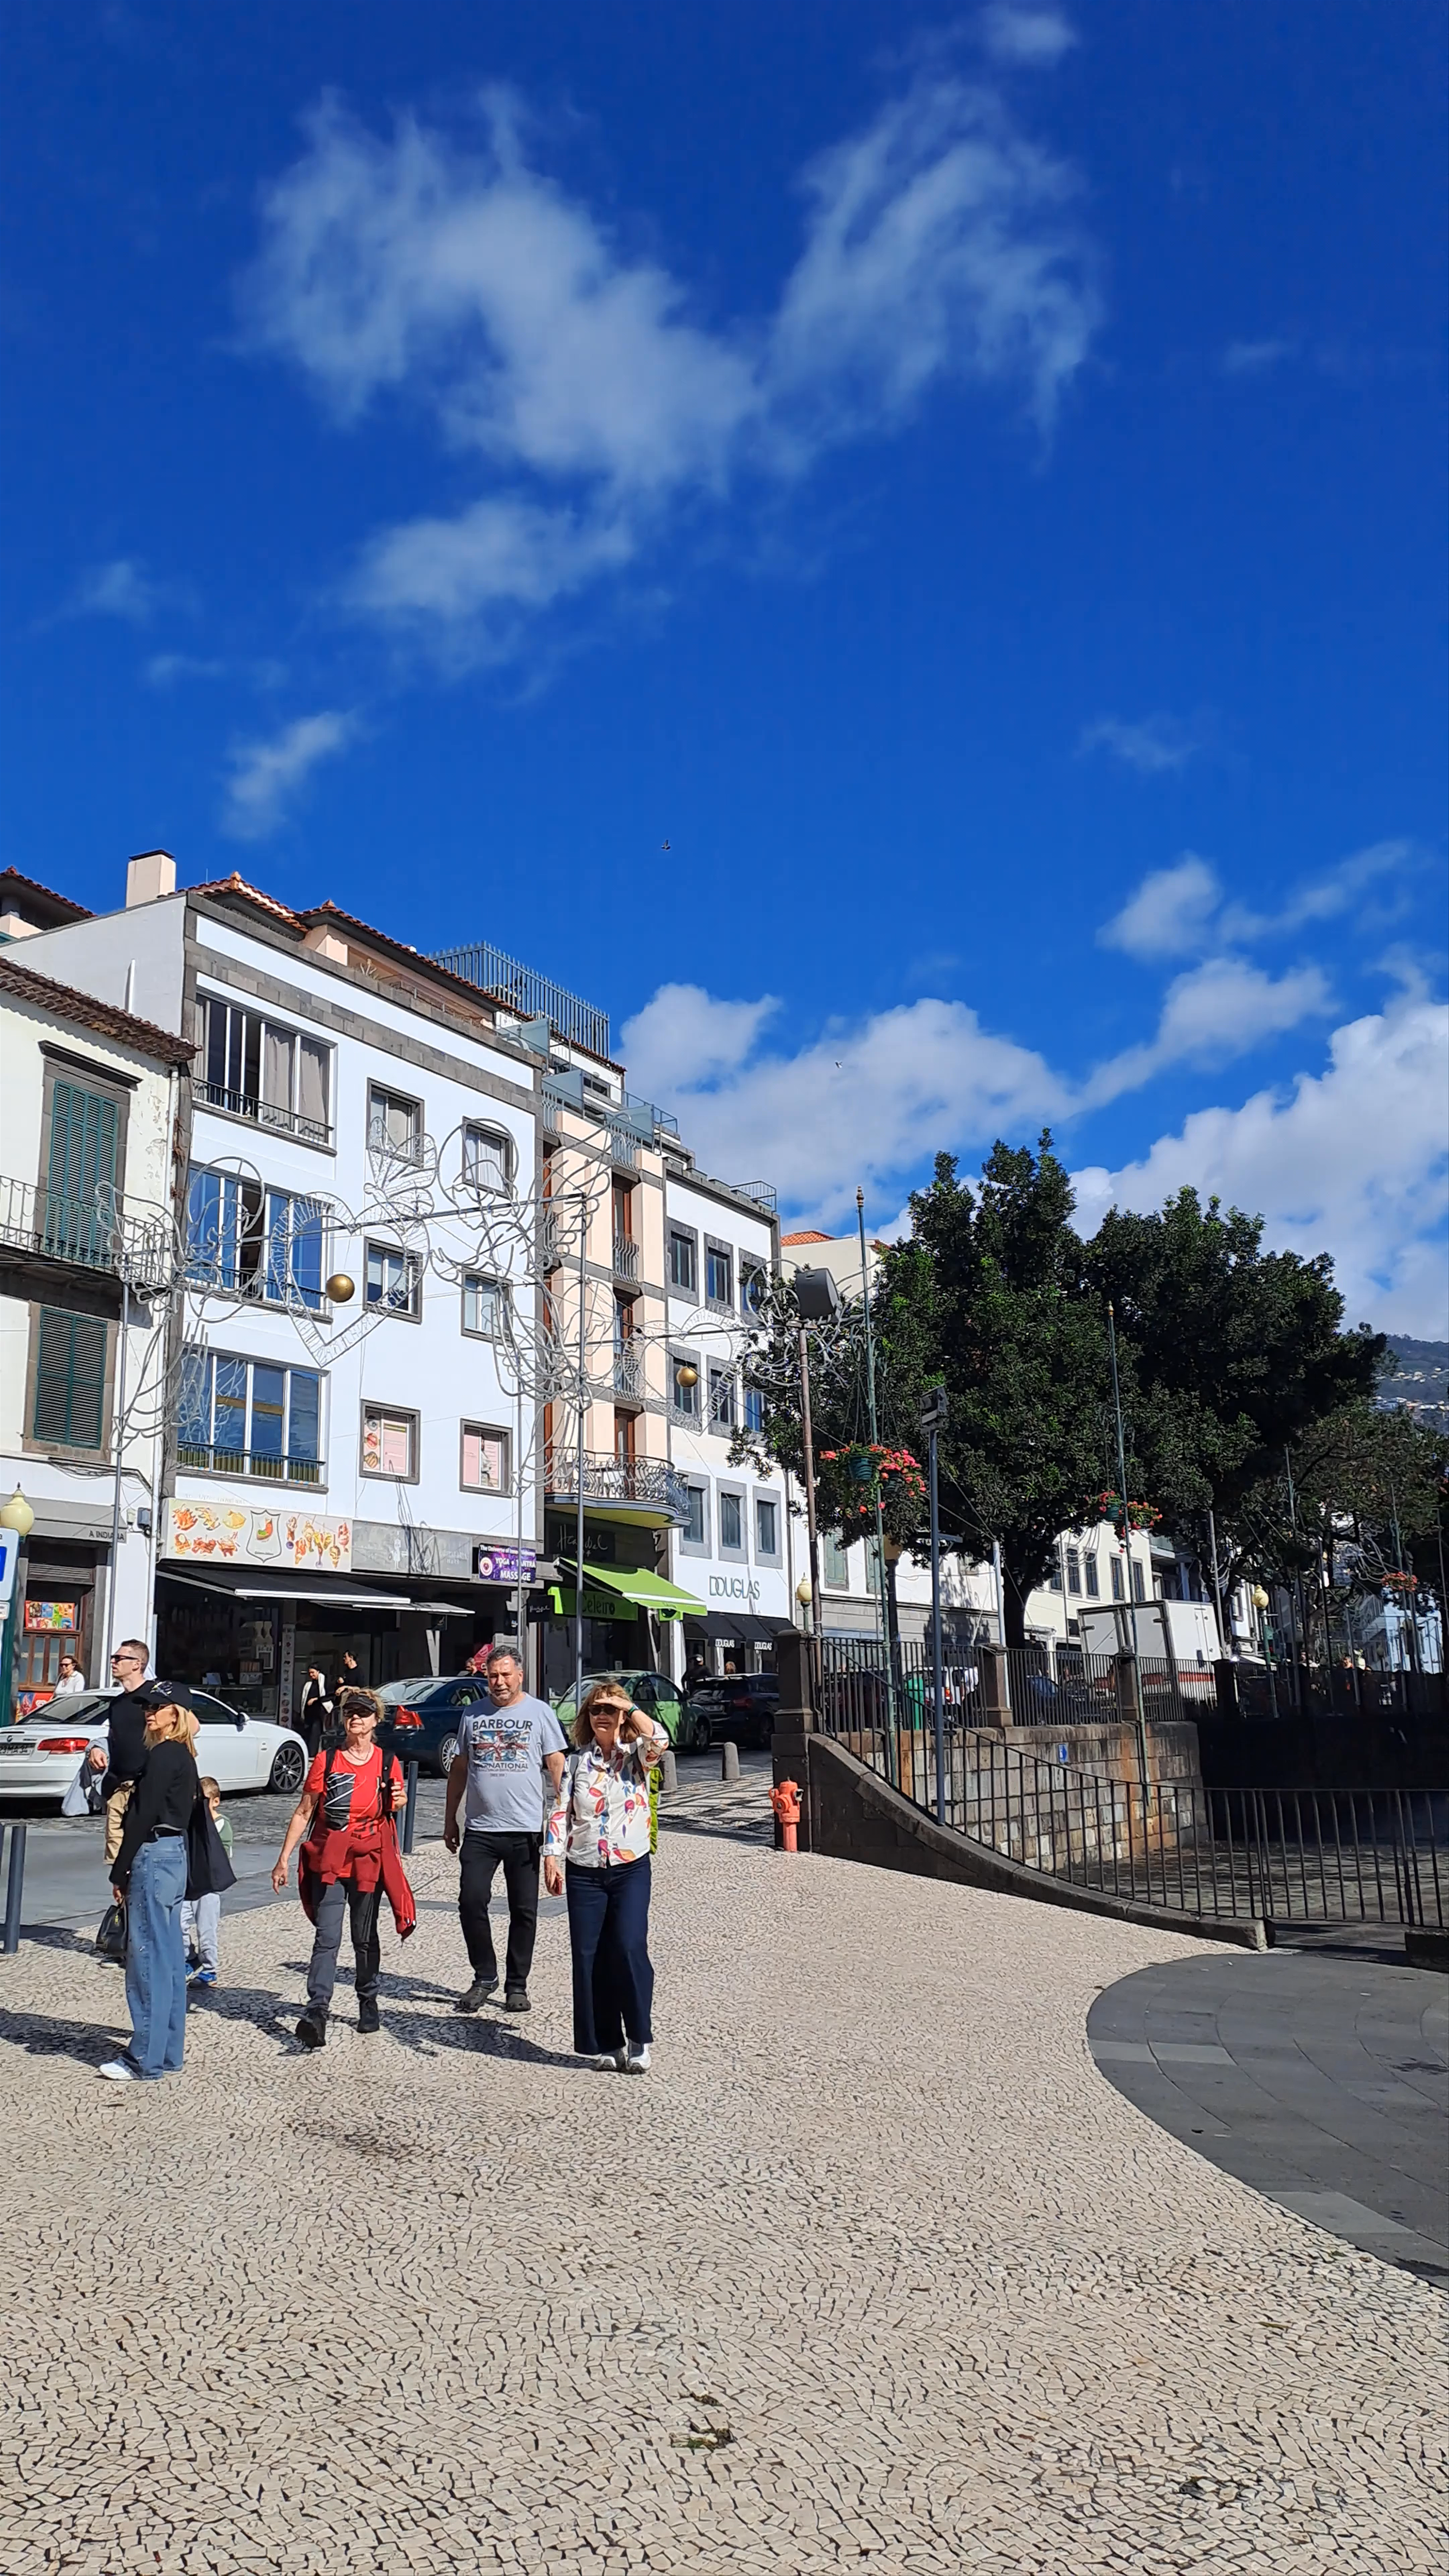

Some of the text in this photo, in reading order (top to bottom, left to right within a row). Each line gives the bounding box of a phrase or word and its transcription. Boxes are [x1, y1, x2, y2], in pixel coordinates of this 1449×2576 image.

[495, 1557, 536, 1568] YOGA TNTRA
[500, 1570, 531, 1581] MASSGE
[709, 1575, 760, 1600] DOUGLAS
[715, 1638, 735, 1648] DOUGLAS
[754, 1641, 772, 1650] DOUGLAS
[472, 1719, 533, 1731] BARBOUR
